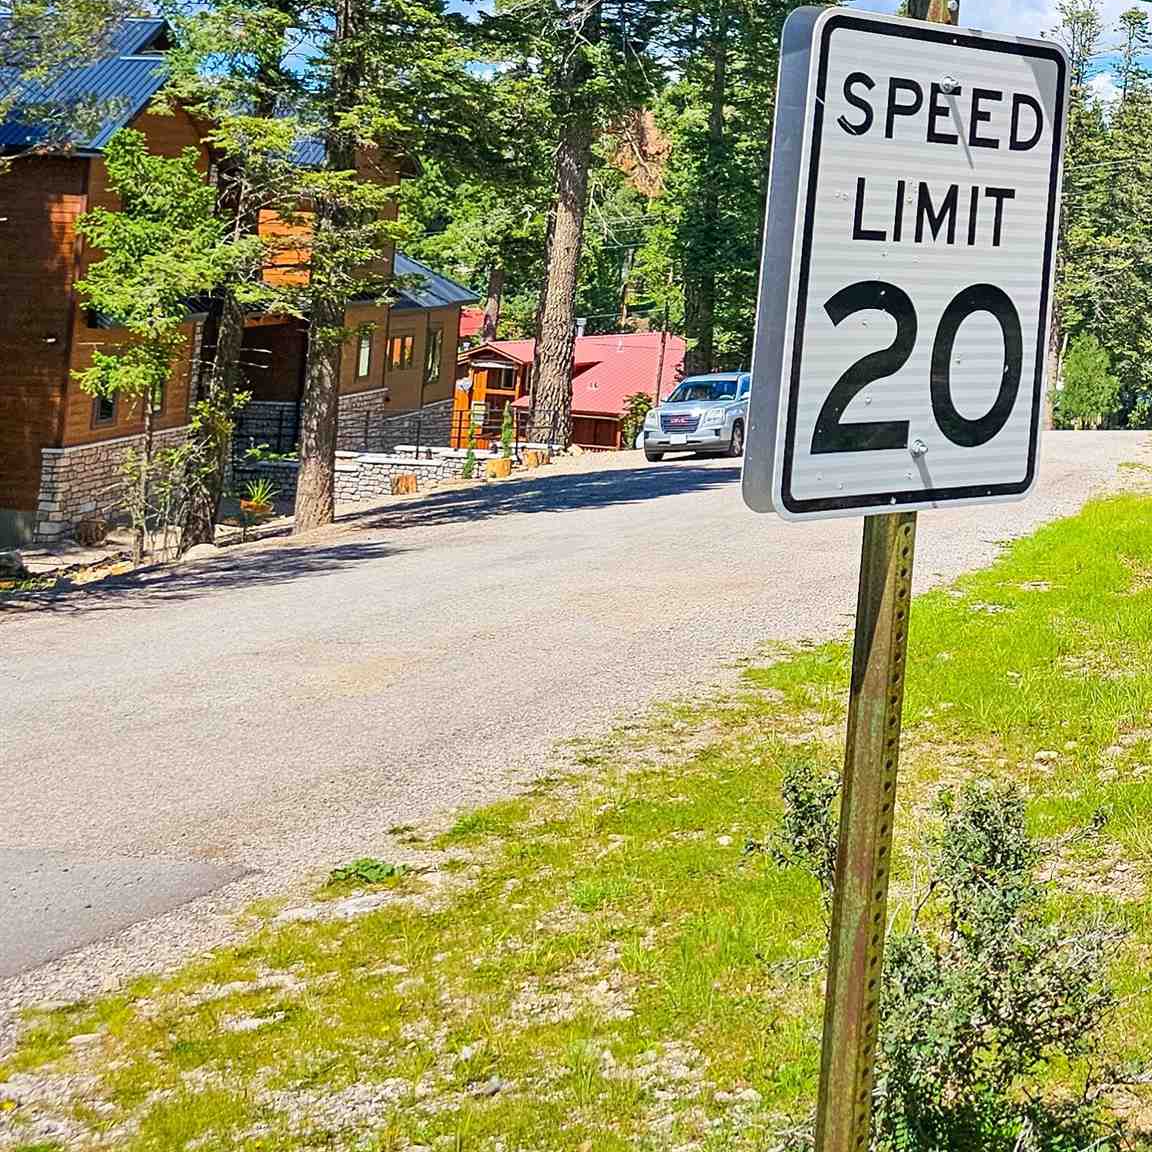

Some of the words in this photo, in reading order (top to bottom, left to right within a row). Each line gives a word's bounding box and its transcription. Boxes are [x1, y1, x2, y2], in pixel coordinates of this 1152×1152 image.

[837, 71, 1043, 151] SPEED
[852, 177, 1016, 247] LIMIT
[810, 280, 1024, 455] 20
